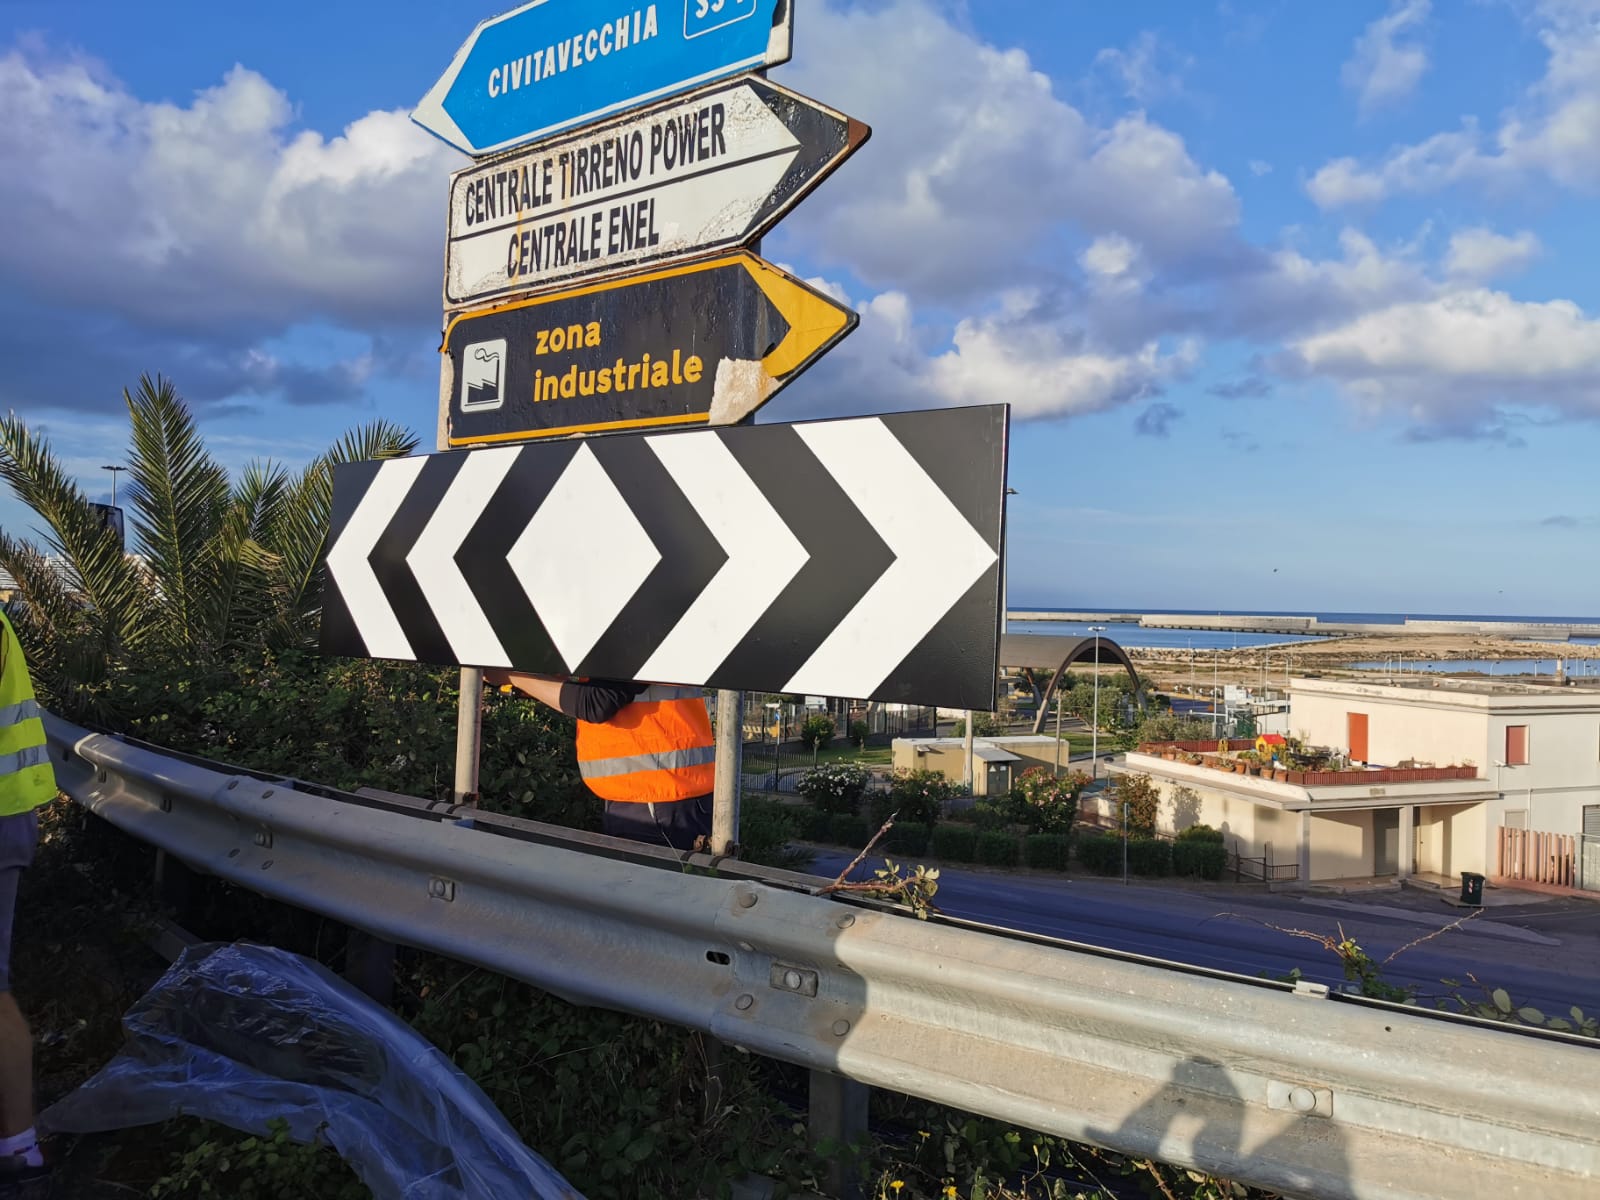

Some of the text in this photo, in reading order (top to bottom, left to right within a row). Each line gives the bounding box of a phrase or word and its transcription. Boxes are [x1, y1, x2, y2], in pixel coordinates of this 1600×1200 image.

[488, 4, 658, 98] CIVITAVECCHIA
[466, 103, 726, 227] CENTRALE TIRRENO POWER
[507, 198, 660, 278] CENTRALE ENEL
[534, 349, 704, 402] industriale
[535, 320, 602, 356] zona
